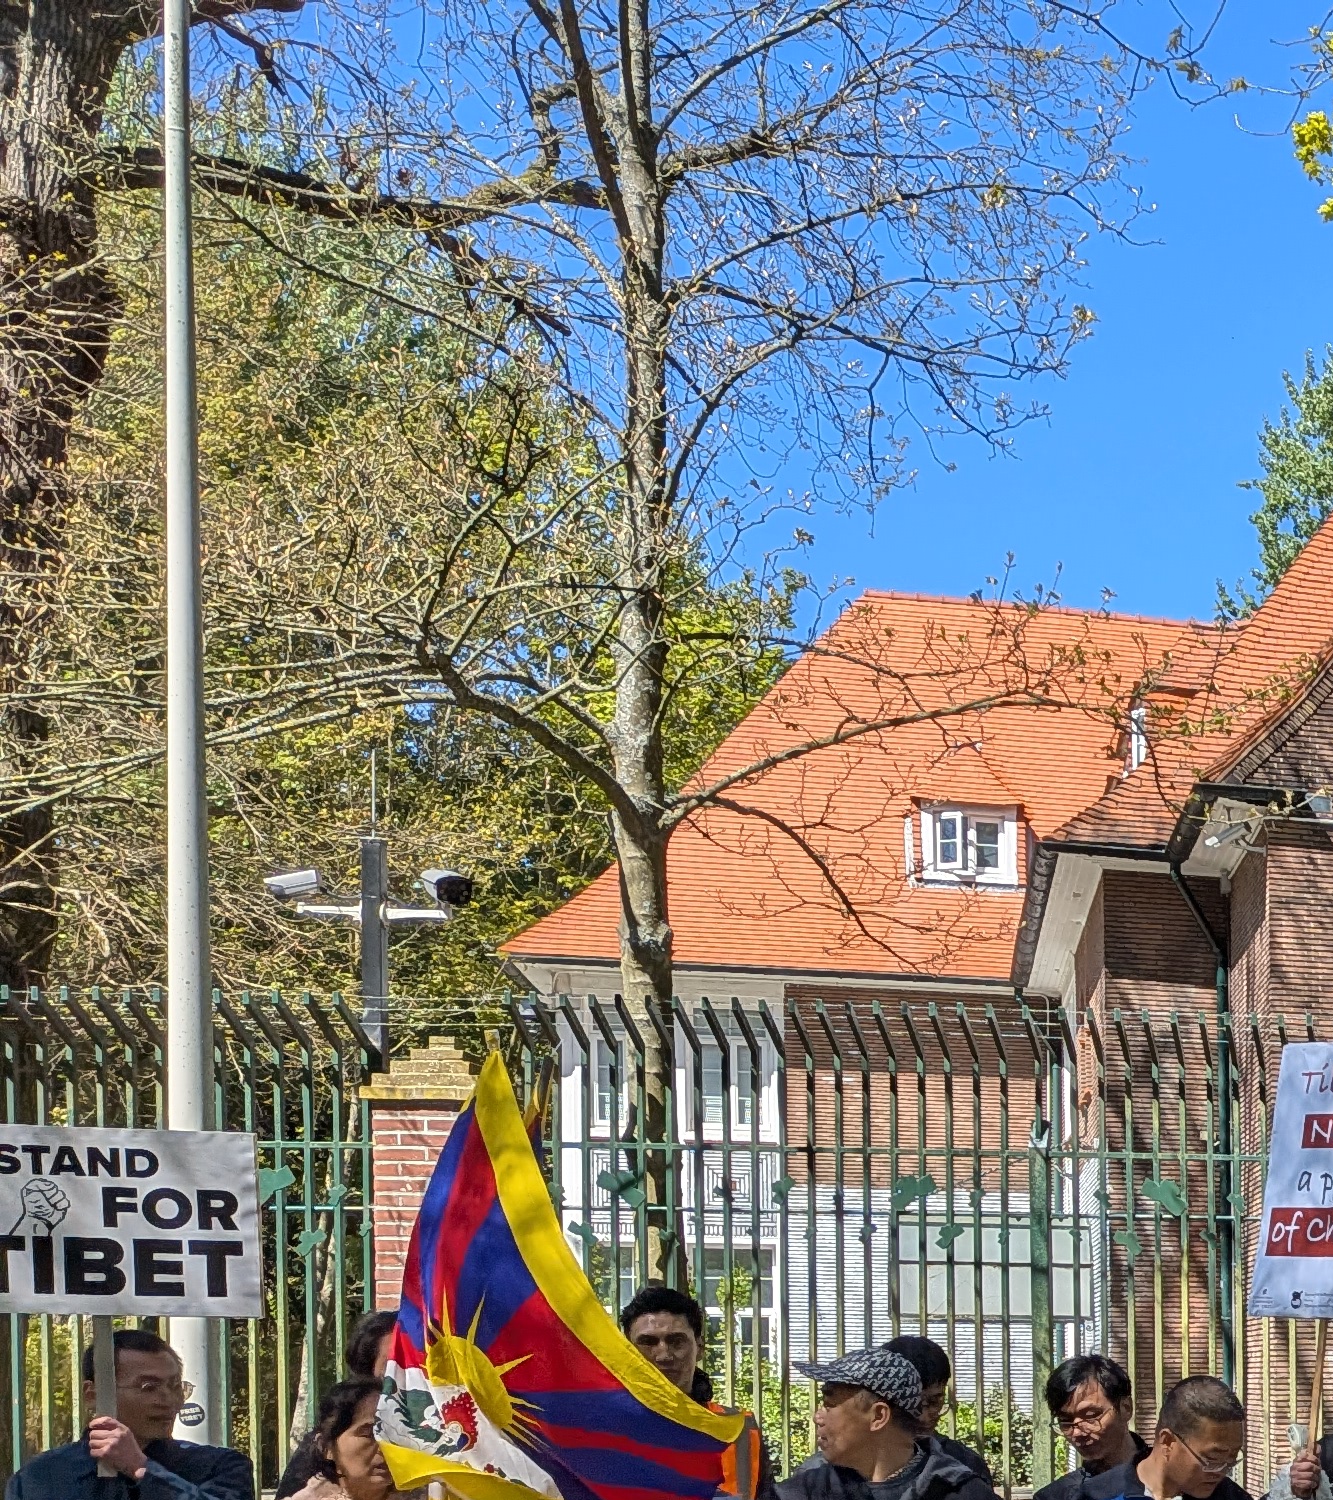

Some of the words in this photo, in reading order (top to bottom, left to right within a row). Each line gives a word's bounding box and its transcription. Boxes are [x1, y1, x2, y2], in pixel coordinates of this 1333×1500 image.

[0, 1144, 159, 1178] STAND
[1298, 1170, 1312, 1192] a
[102, 1187, 239, 1230] FOR
[1271, 1210, 1303, 1252] of
